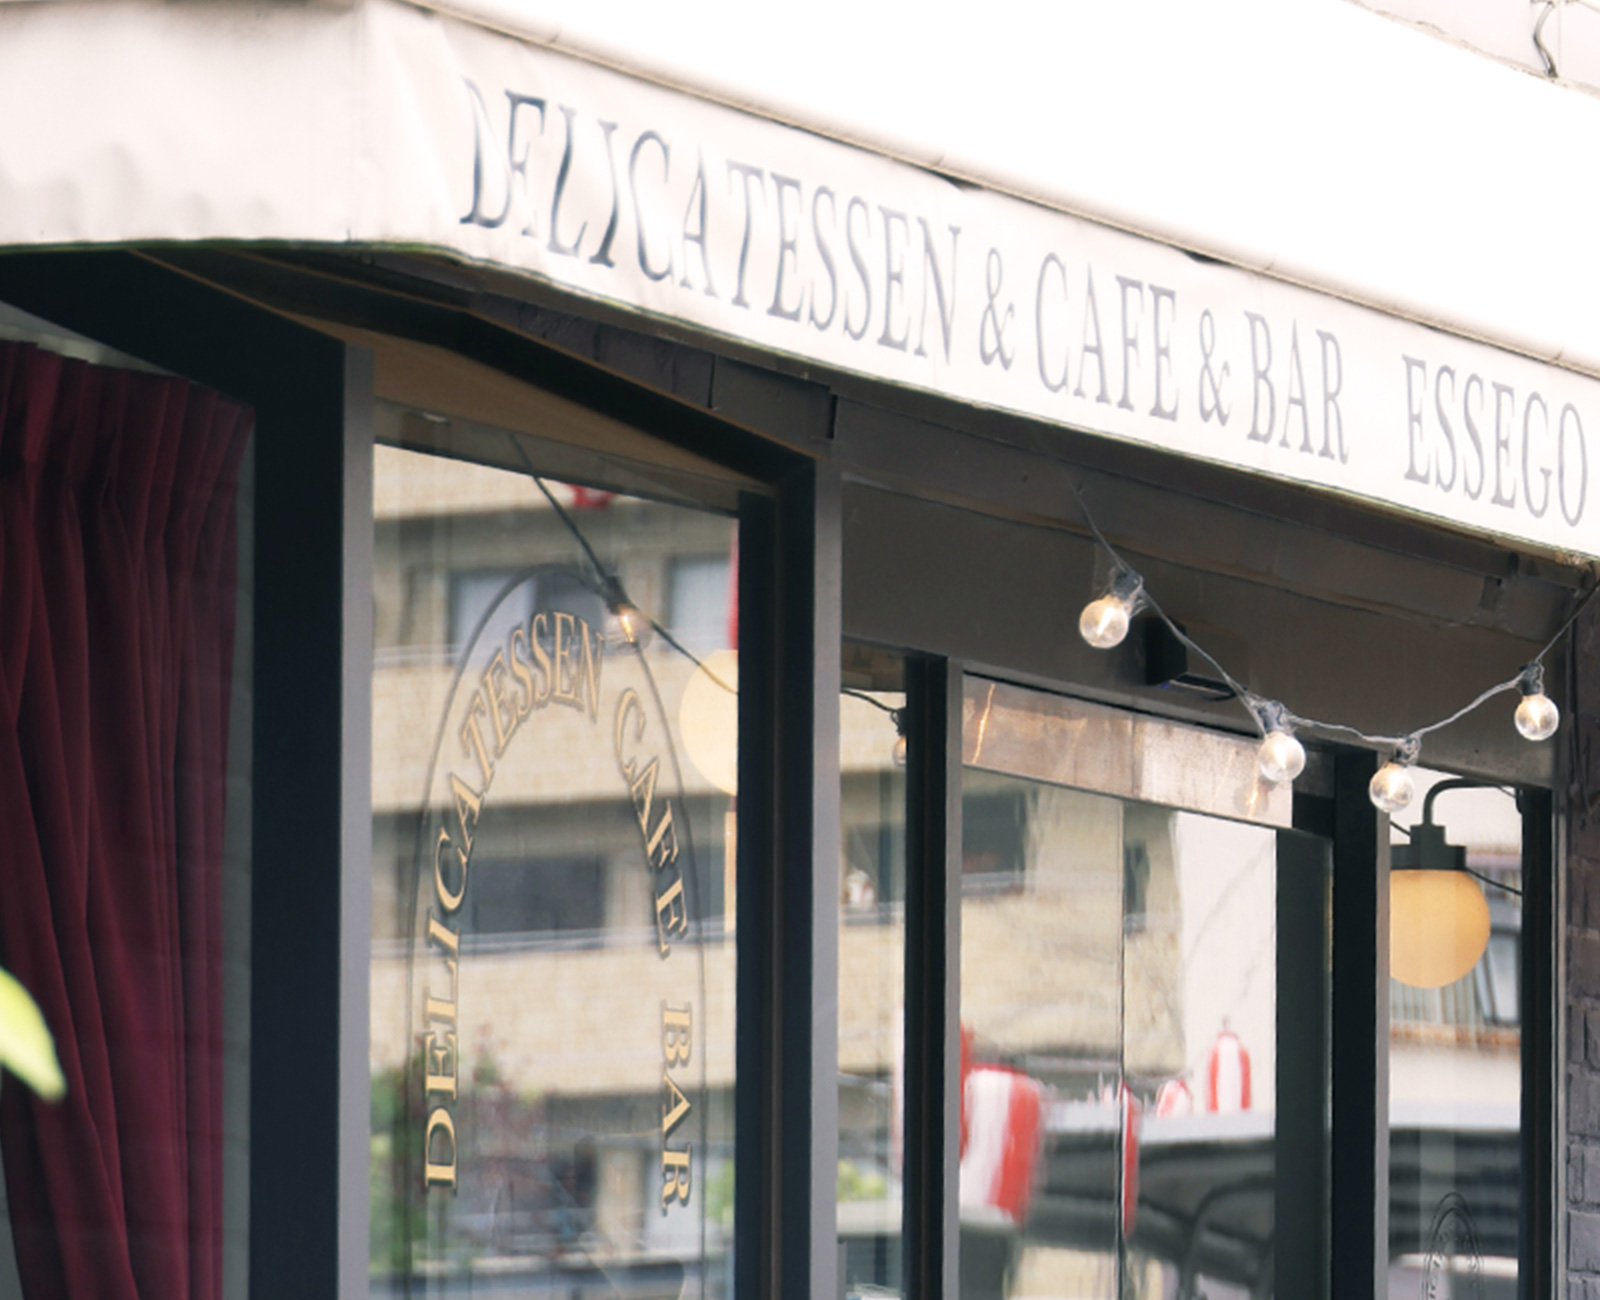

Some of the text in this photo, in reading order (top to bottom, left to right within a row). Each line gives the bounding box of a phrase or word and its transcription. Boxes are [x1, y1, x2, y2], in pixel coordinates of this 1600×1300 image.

[460, 75, 1588, 527] DELICATESSEN & CAFE & BAR ESSEGO
[424, 610, 692, 1217] DELICATESSEN CAFE BAR
